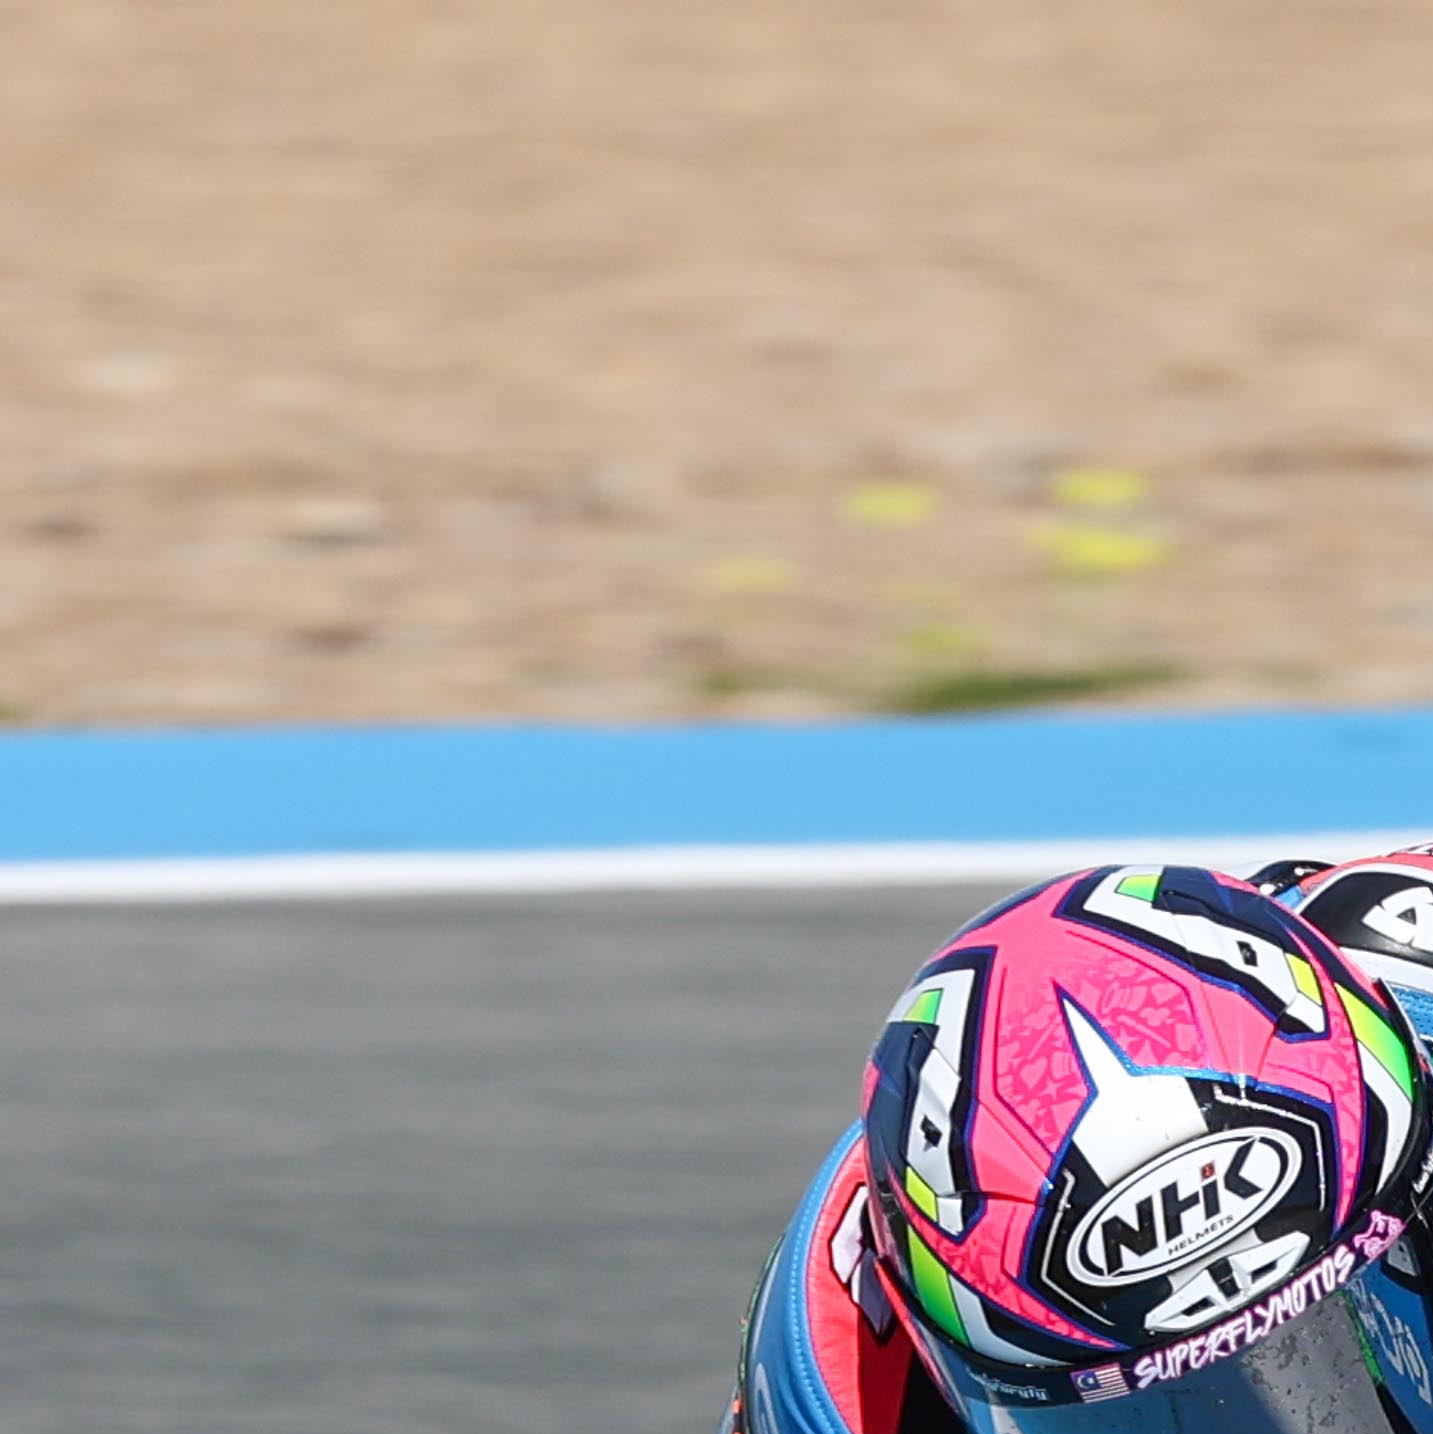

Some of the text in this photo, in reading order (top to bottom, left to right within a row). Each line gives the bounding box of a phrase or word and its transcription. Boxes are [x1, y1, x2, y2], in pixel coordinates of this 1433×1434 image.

[1100, 1137, 1263, 1277] NHK
[1168, 1214, 1234, 1255] HELMETS
[1133, 1245, 1356, 1389] SUPERFLYMOTOS
